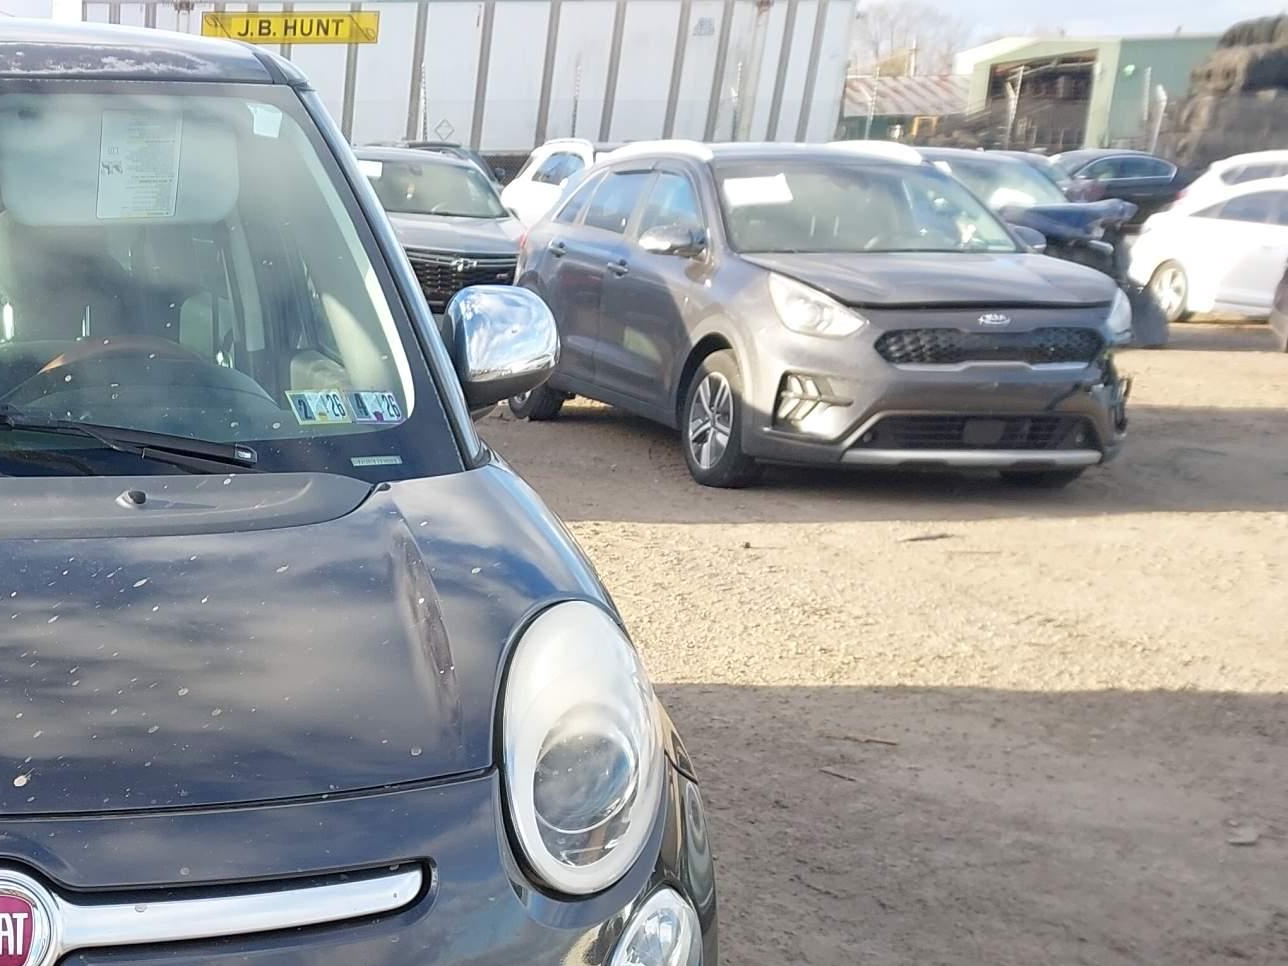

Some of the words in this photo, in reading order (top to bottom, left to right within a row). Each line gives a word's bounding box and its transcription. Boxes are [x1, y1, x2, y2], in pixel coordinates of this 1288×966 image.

[237, 19, 277, 37] J.B.
[283, 19, 345, 36] HUNT
[326, 394, 346, 417] 26
[381, 394, 401, 418] 26
